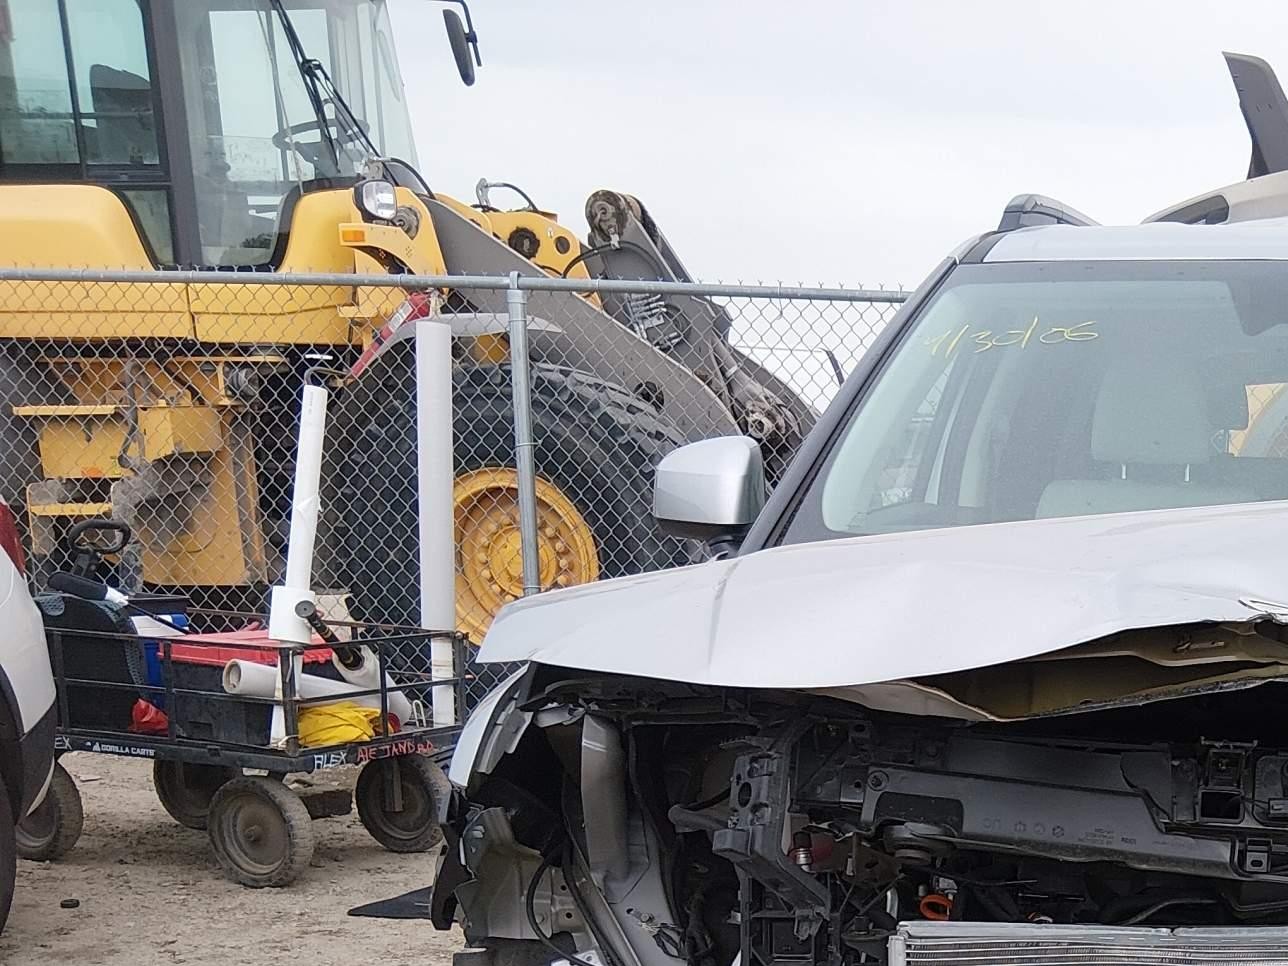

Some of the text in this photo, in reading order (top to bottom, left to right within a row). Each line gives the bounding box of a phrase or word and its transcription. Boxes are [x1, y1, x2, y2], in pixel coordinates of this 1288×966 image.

[101, 744, 156, 756] GORILLA CARTS
[314, 751, 347, 769] ALEX
